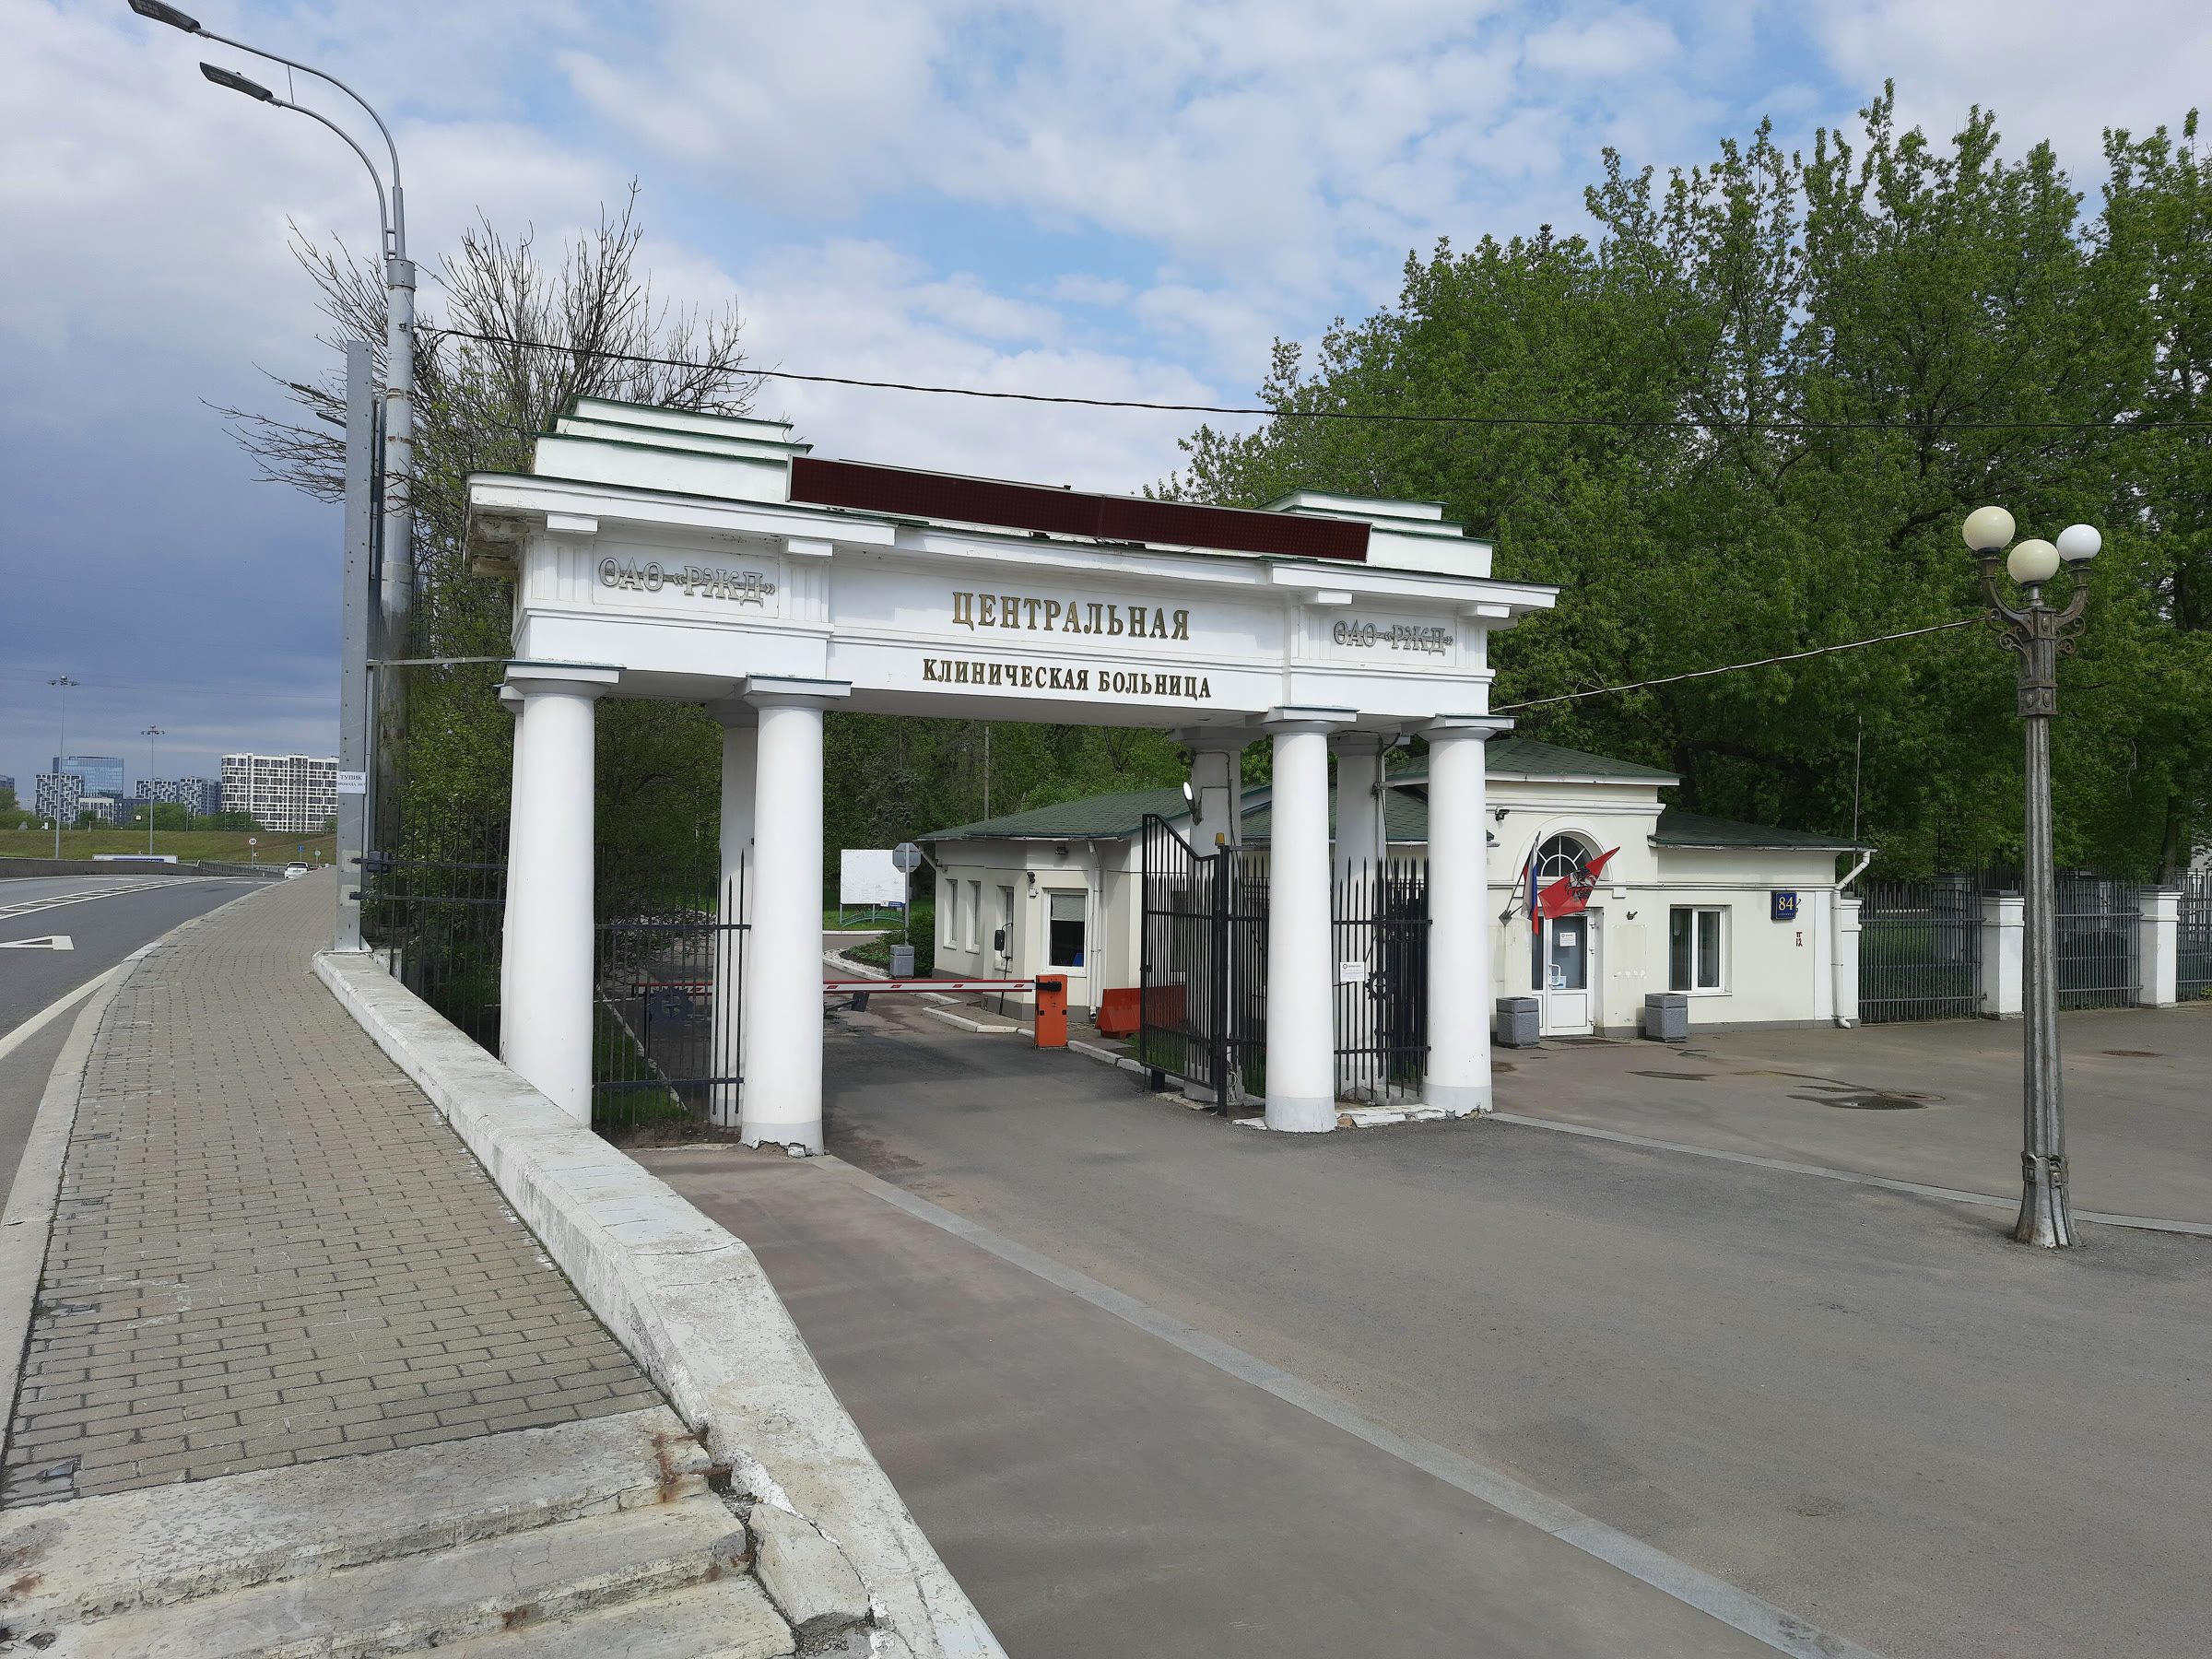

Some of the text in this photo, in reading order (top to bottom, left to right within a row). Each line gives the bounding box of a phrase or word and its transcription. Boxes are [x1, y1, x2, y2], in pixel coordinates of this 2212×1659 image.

[598, 557, 776, 607] ОАО «РЖД»
[952, 591, 1190, 641] ЦЕНТРАЛЬНАЯ
[1334, 619, 1378, 648] ОАО
[923, 658, 1212, 700] КЛИНИЧЕСКАЯ БОЛЬНИЦА
[1778, 896, 1794, 911] 84
